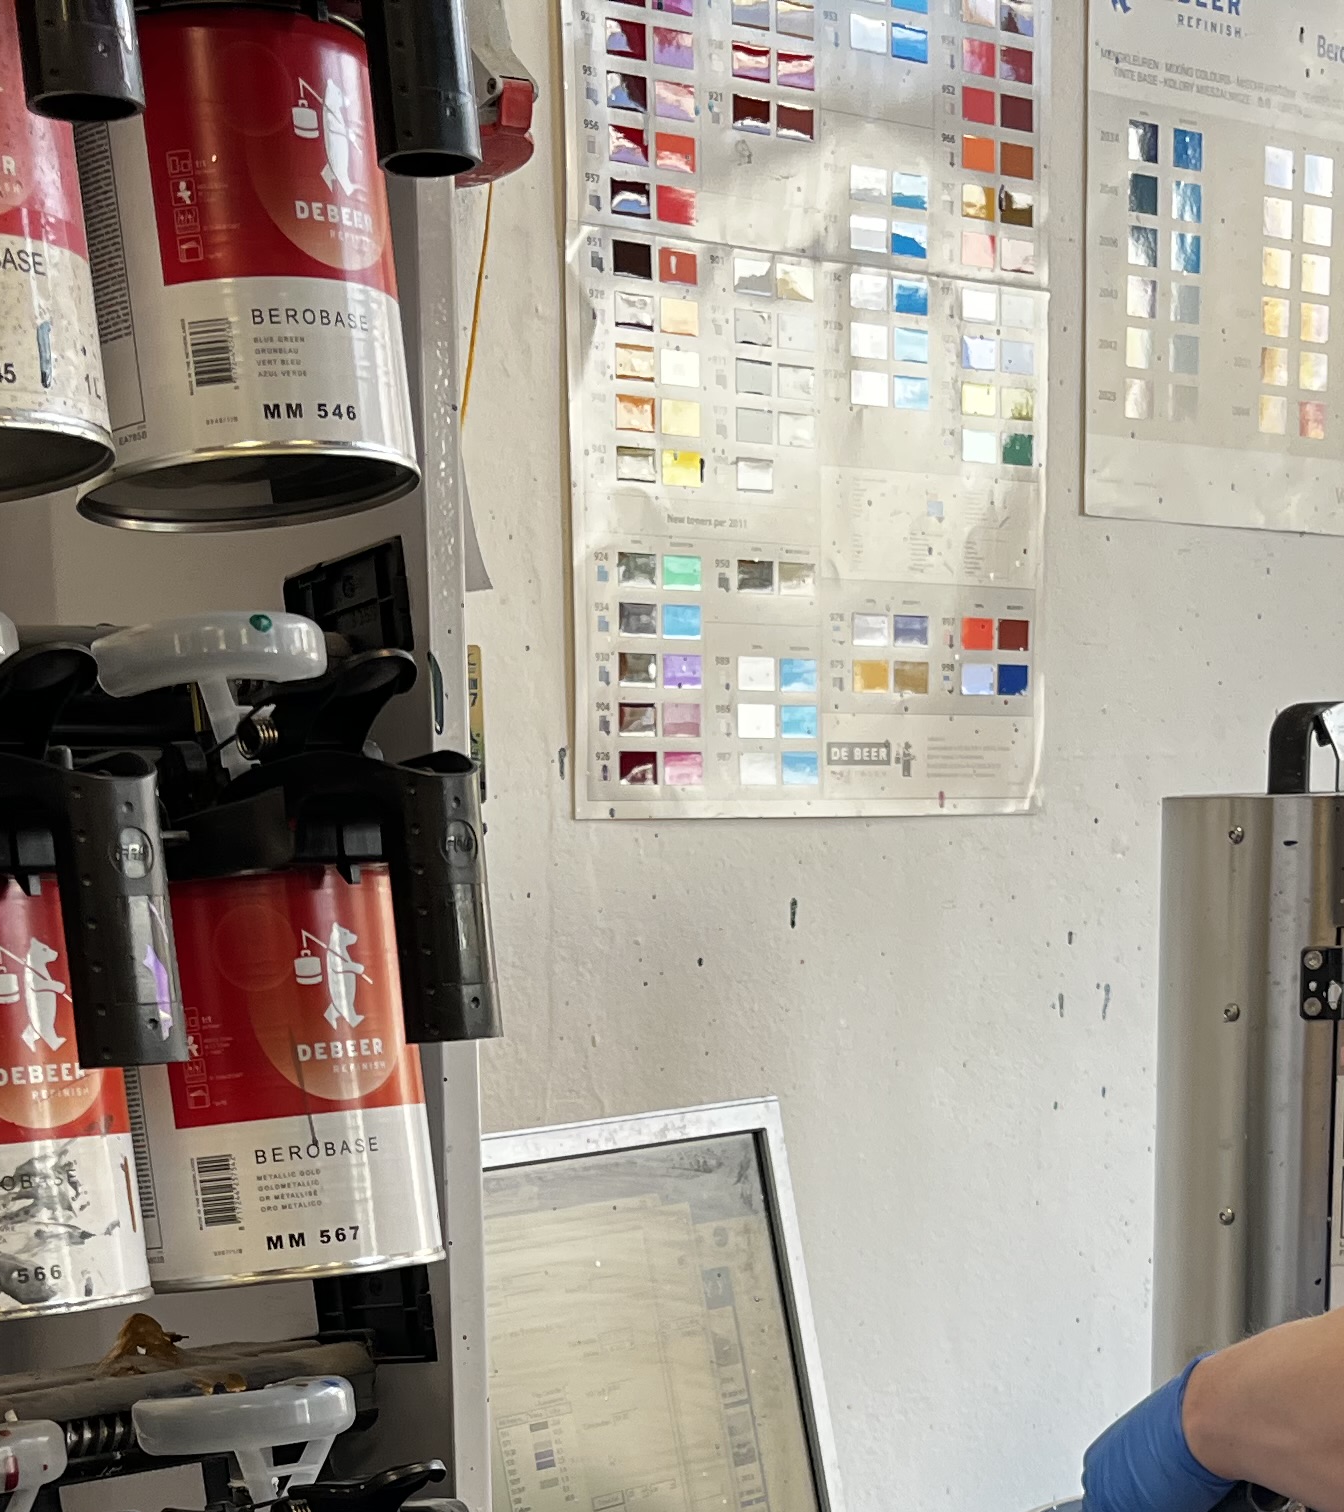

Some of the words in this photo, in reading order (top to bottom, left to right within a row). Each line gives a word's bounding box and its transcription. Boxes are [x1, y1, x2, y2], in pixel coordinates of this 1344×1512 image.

[1177, 13, 1243, 39] REFINISH
[295, 201, 374, 231] DEBEER
[251, 308, 369, 332] BEROBASE
[263, 403, 304, 421] MM
[317, 403, 357, 421] 546
[830, 746, 849, 761] DE
[853, 746, 888, 761] BEER
[297, 1036, 384, 1062] DEBEER
[254, 1136, 380, 1165] BEROBASE
[266, 1232, 307, 1251] MM
[319, 1225, 361, 1245] 567
[17, 1264, 63, 1284] 566
